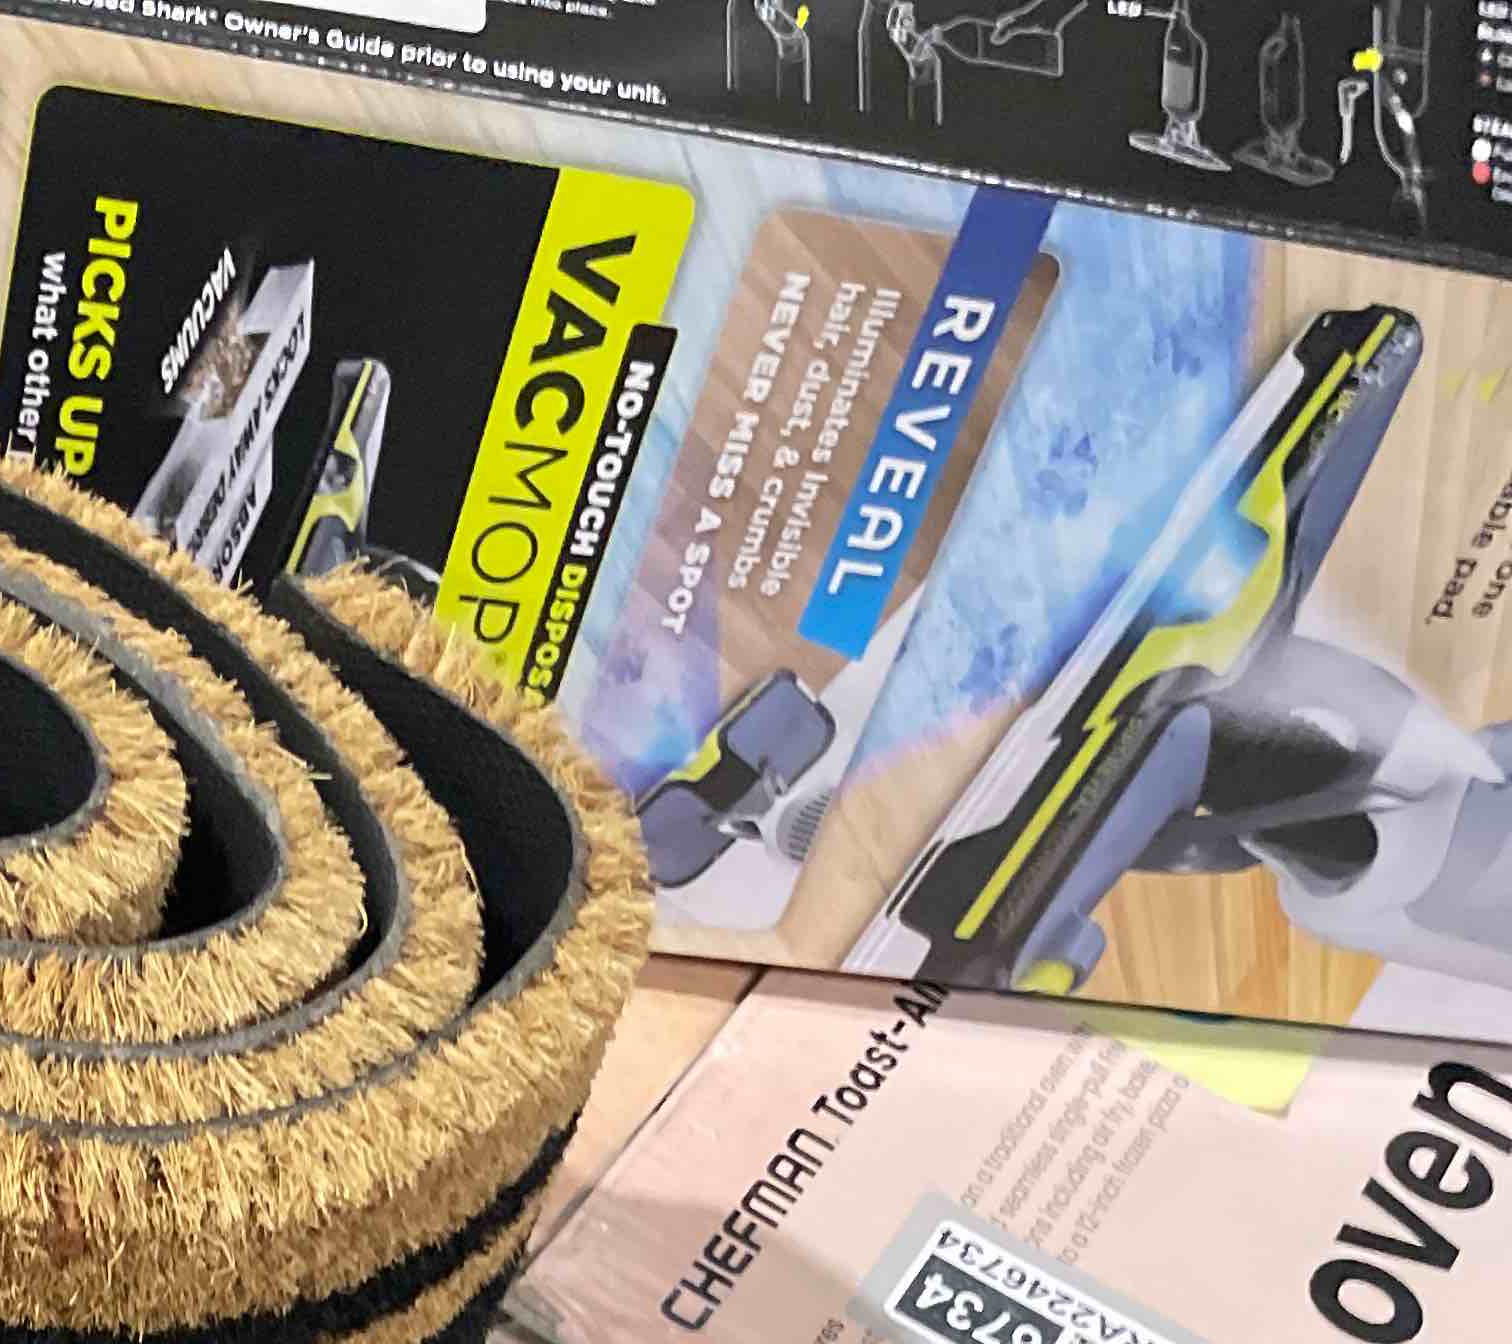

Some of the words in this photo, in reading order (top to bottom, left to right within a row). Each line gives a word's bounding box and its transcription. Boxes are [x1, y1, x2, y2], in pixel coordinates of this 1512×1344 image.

[327, 26, 394, 58] Guide
[401, 42, 457, 69] prior
[462, 51, 486, 74] to
[493, 60, 554, 88] using
[560, 71, 611, 95] your
[32, 251, 68, 341] what
[68, 196, 138, 382] PICKS
[743, 271, 811, 403] NEVER
[17, 349, 52, 447] other
[780, 359, 832, 437] dust,
[812, 288, 902, 463] Illuminates
[54, 397, 104, 476] UP
[458, 233, 637, 645] VACMOP
[570, 360, 655, 557] NO-TOUCH
[708, 411, 760, 500] MISS
[828, 295, 995, 595] REVEAL
[695, 508, 722, 533] A
[728, 477, 785, 589] crumbs
[662, 542, 711, 634] SPOT
[661, 1128, 835, 1330] CHEFMAN
